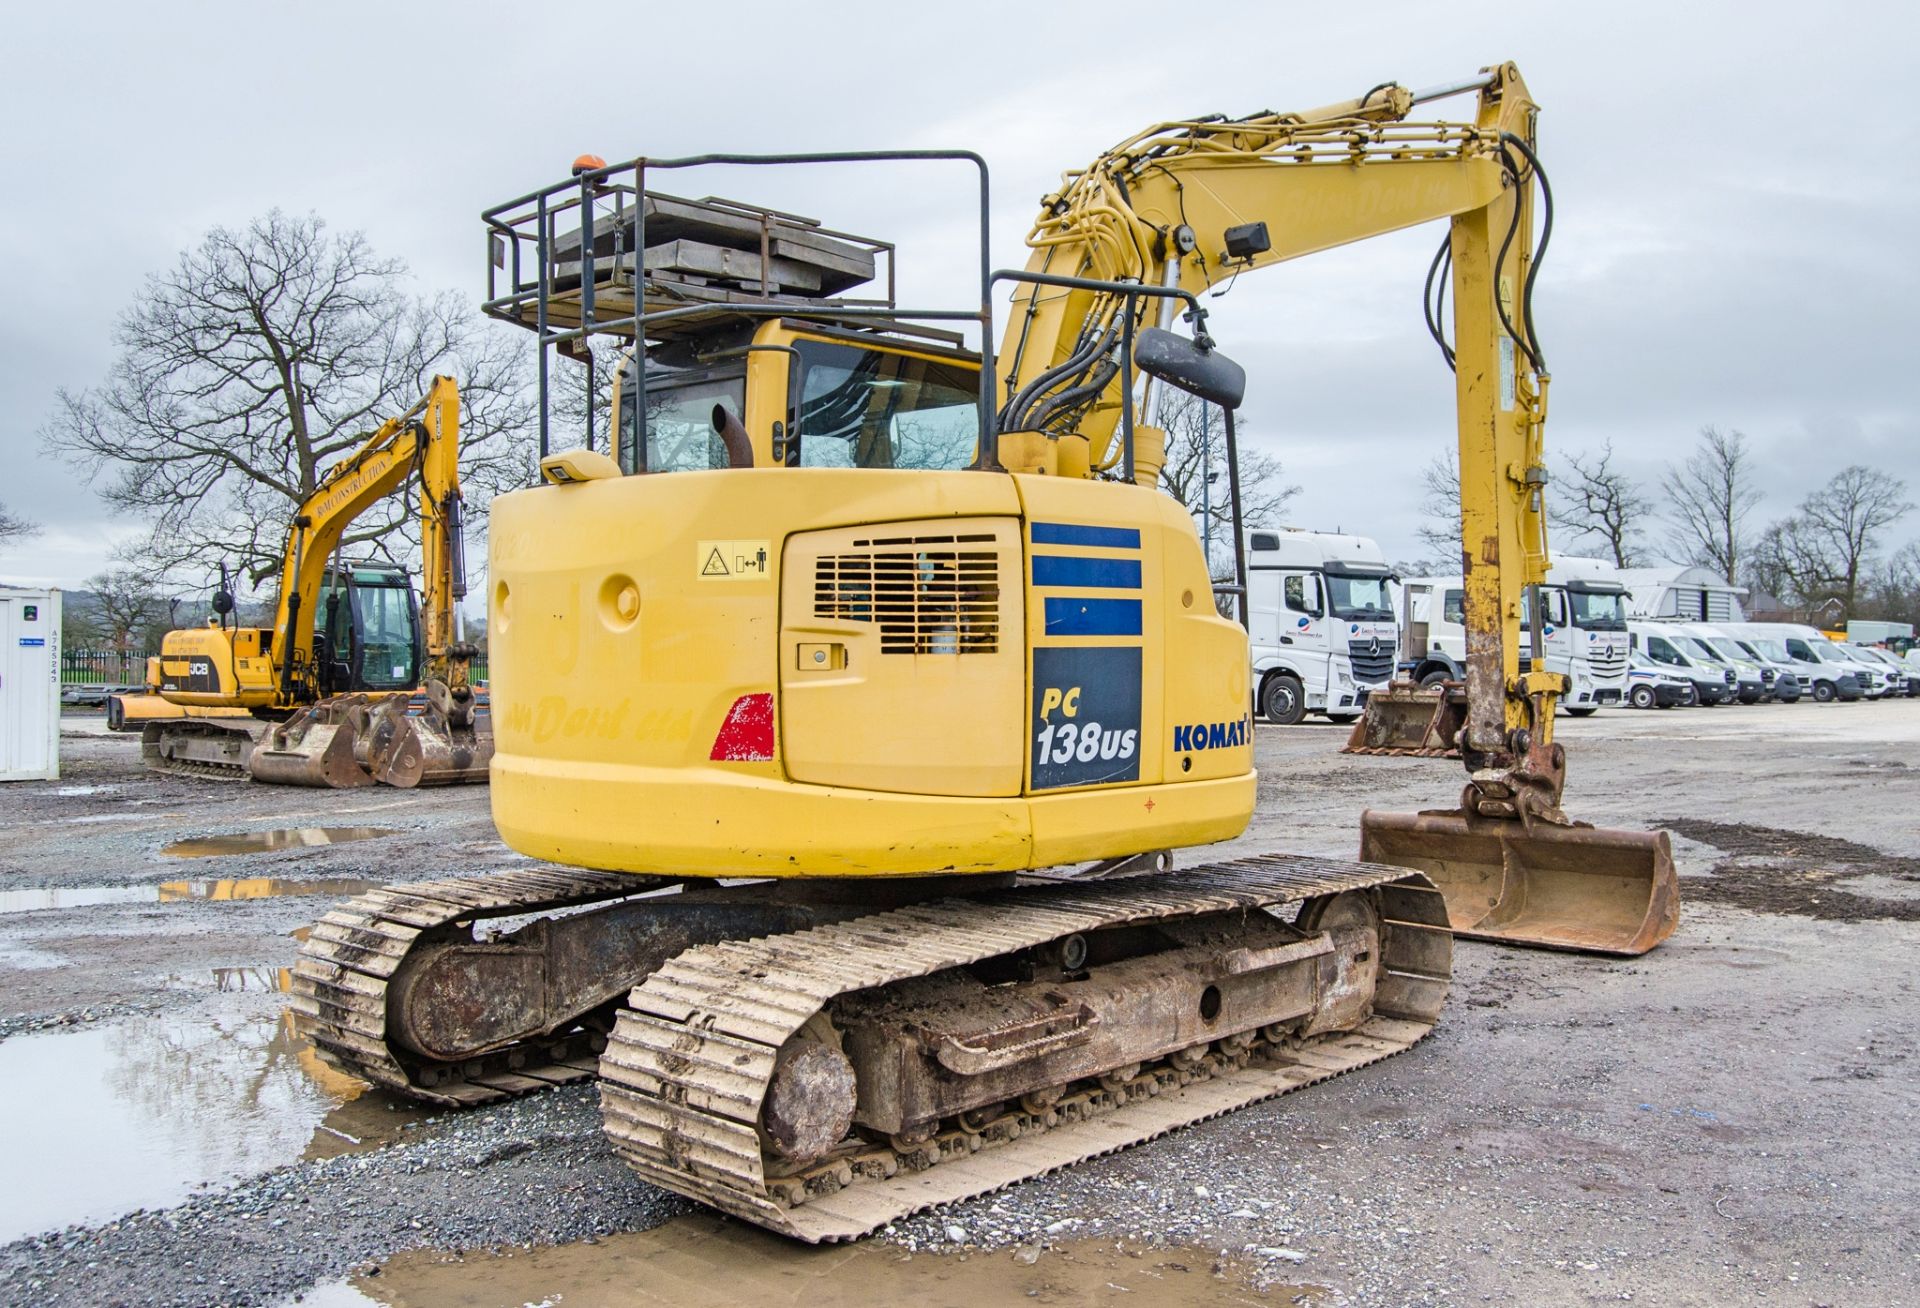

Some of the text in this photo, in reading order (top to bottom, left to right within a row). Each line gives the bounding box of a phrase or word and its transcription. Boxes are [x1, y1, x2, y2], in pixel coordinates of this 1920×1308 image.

[190, 663, 208, 675] JCB
[1040, 687, 1081, 719] PC
[1038, 722, 1138, 765] 138US
